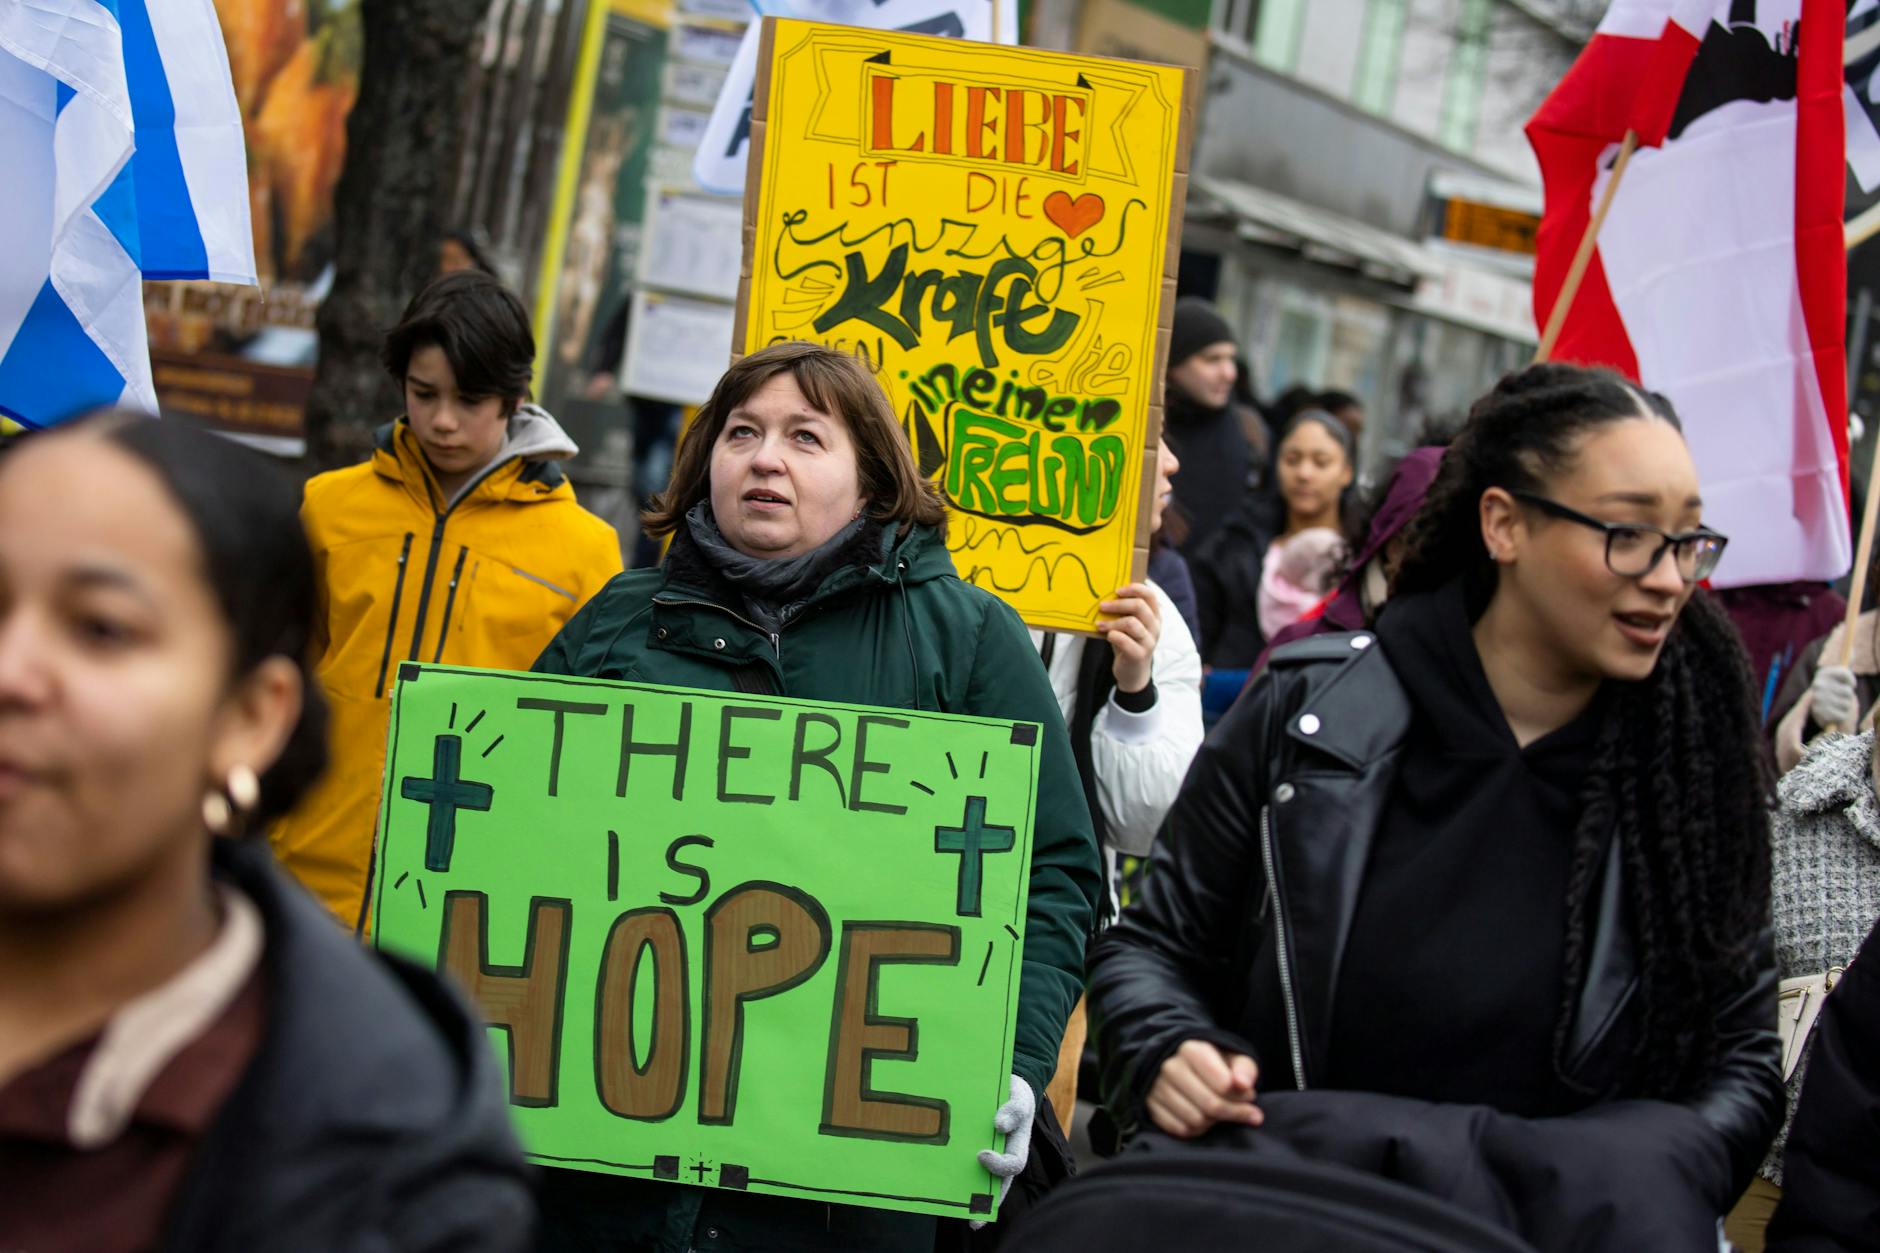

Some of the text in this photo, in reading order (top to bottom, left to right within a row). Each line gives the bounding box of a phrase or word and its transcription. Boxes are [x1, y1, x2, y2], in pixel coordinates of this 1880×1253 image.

[870, 75, 1086, 175] LIEBE
[828, 160, 1034, 219] IST DIE
[812, 241, 1081, 369] Kraft
[1027, 297, 1133, 396] die
[946, 408, 1126, 526] FREUND
[516, 697, 910, 815] THERE
[607, 829, 715, 906] IS
[437, 879, 961, 1146] HOPE
